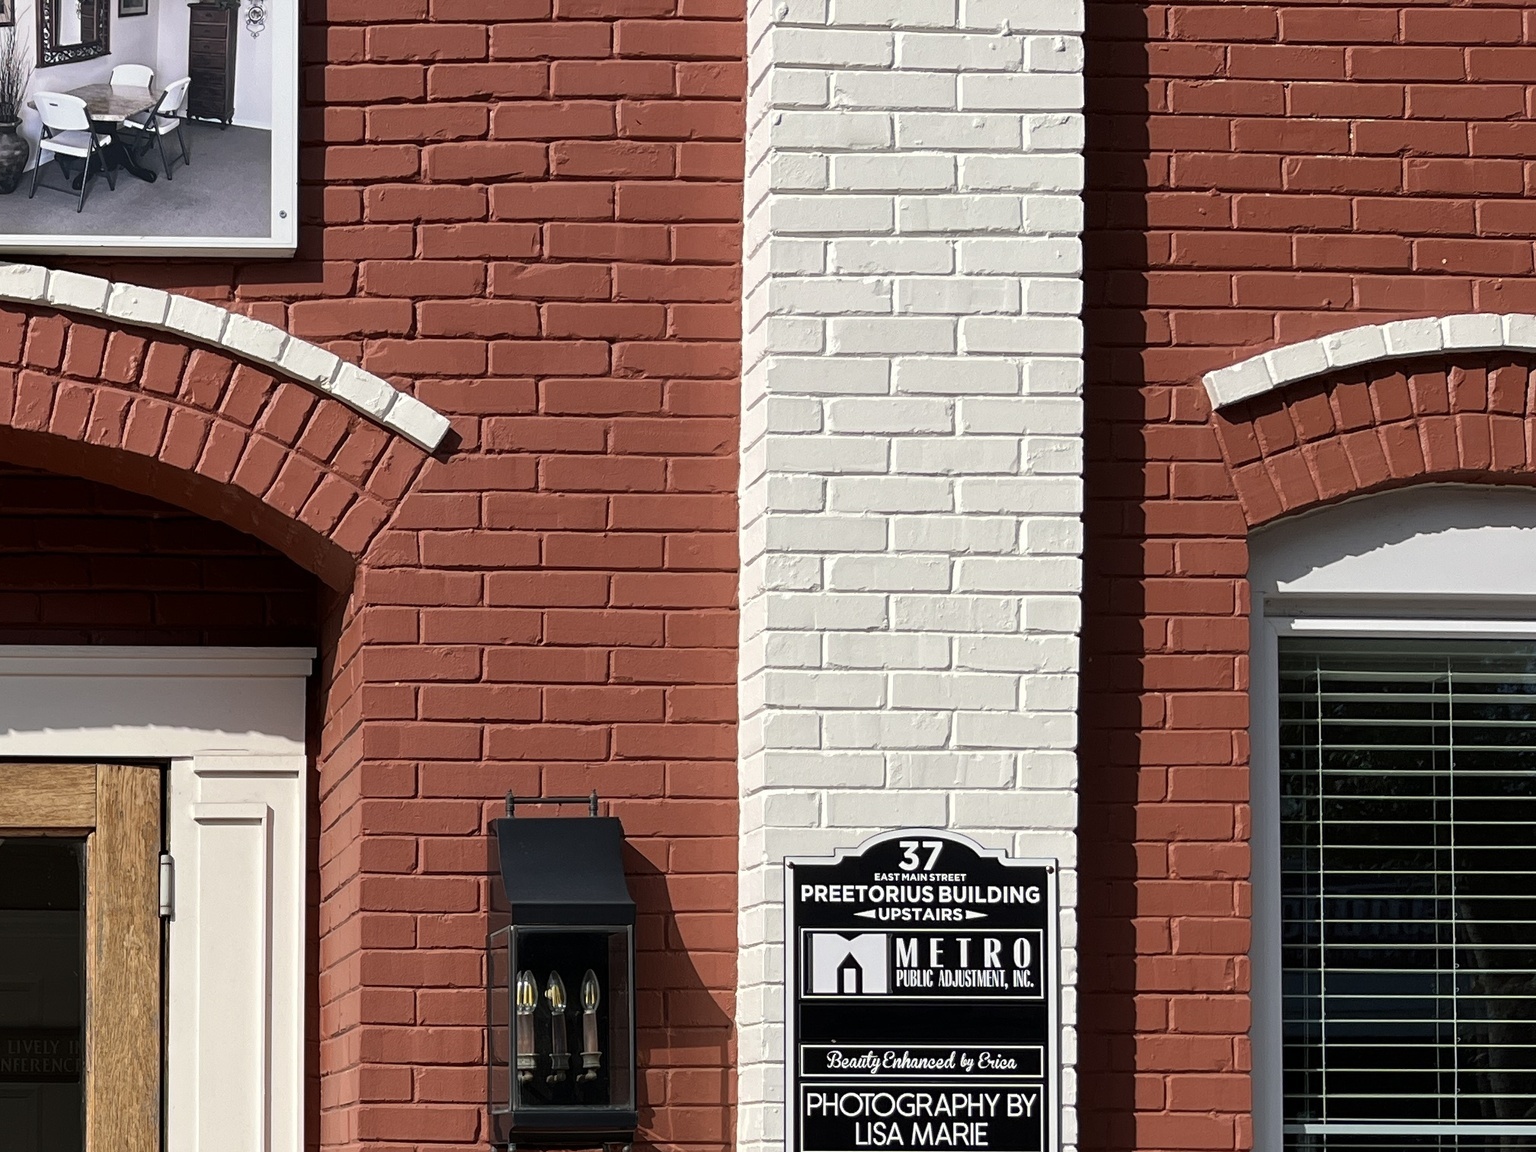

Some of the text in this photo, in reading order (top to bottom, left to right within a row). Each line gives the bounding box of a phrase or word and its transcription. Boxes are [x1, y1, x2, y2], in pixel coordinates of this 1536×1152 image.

[899, 841, 943, 871] 37
[874, 872, 966, 882] EAST MAIN STREET
[801, 885, 1040, 904] PREETORIUS BUILDING
[878, 908, 963, 921] UPSTAIRS
[896, 937, 1031, 968] METRO
[896, 969, 1035, 990] PUBLIC ADJUSTMENT, INC.
[8, 1039, 60, 1054] LIVELY
[827, 1050, 1017, 1074] Beauty Enhanced by Erica
[806, 1092, 1037, 1118] PHOTOGRAPHY BY
[856, 1122, 989, 1146] LISA MARIE
